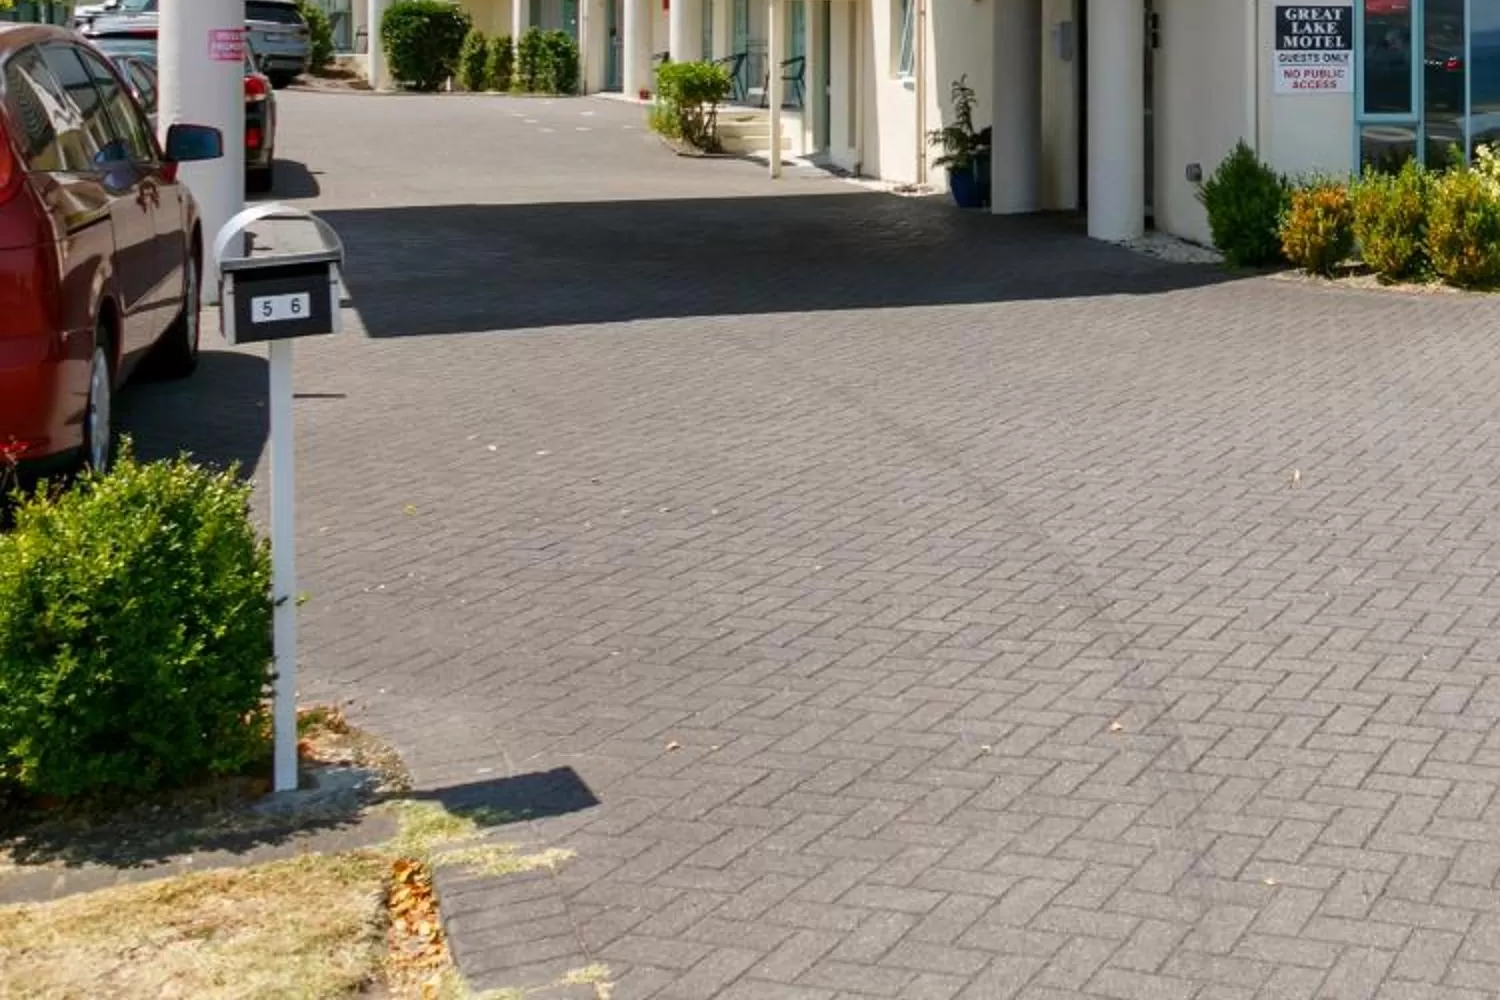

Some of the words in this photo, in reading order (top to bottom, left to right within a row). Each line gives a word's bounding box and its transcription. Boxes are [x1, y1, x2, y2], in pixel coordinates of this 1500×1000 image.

[1284, 7, 1344, 21] GREAT
[1291, 21, 1338, 34] LAKE
[1283, 35, 1345, 49] MOTEL
[1283, 69, 1301, 79] NO
[1303, 69, 1345, 79] PUBLIC
[1291, 79, 1337, 89] ACCESS
